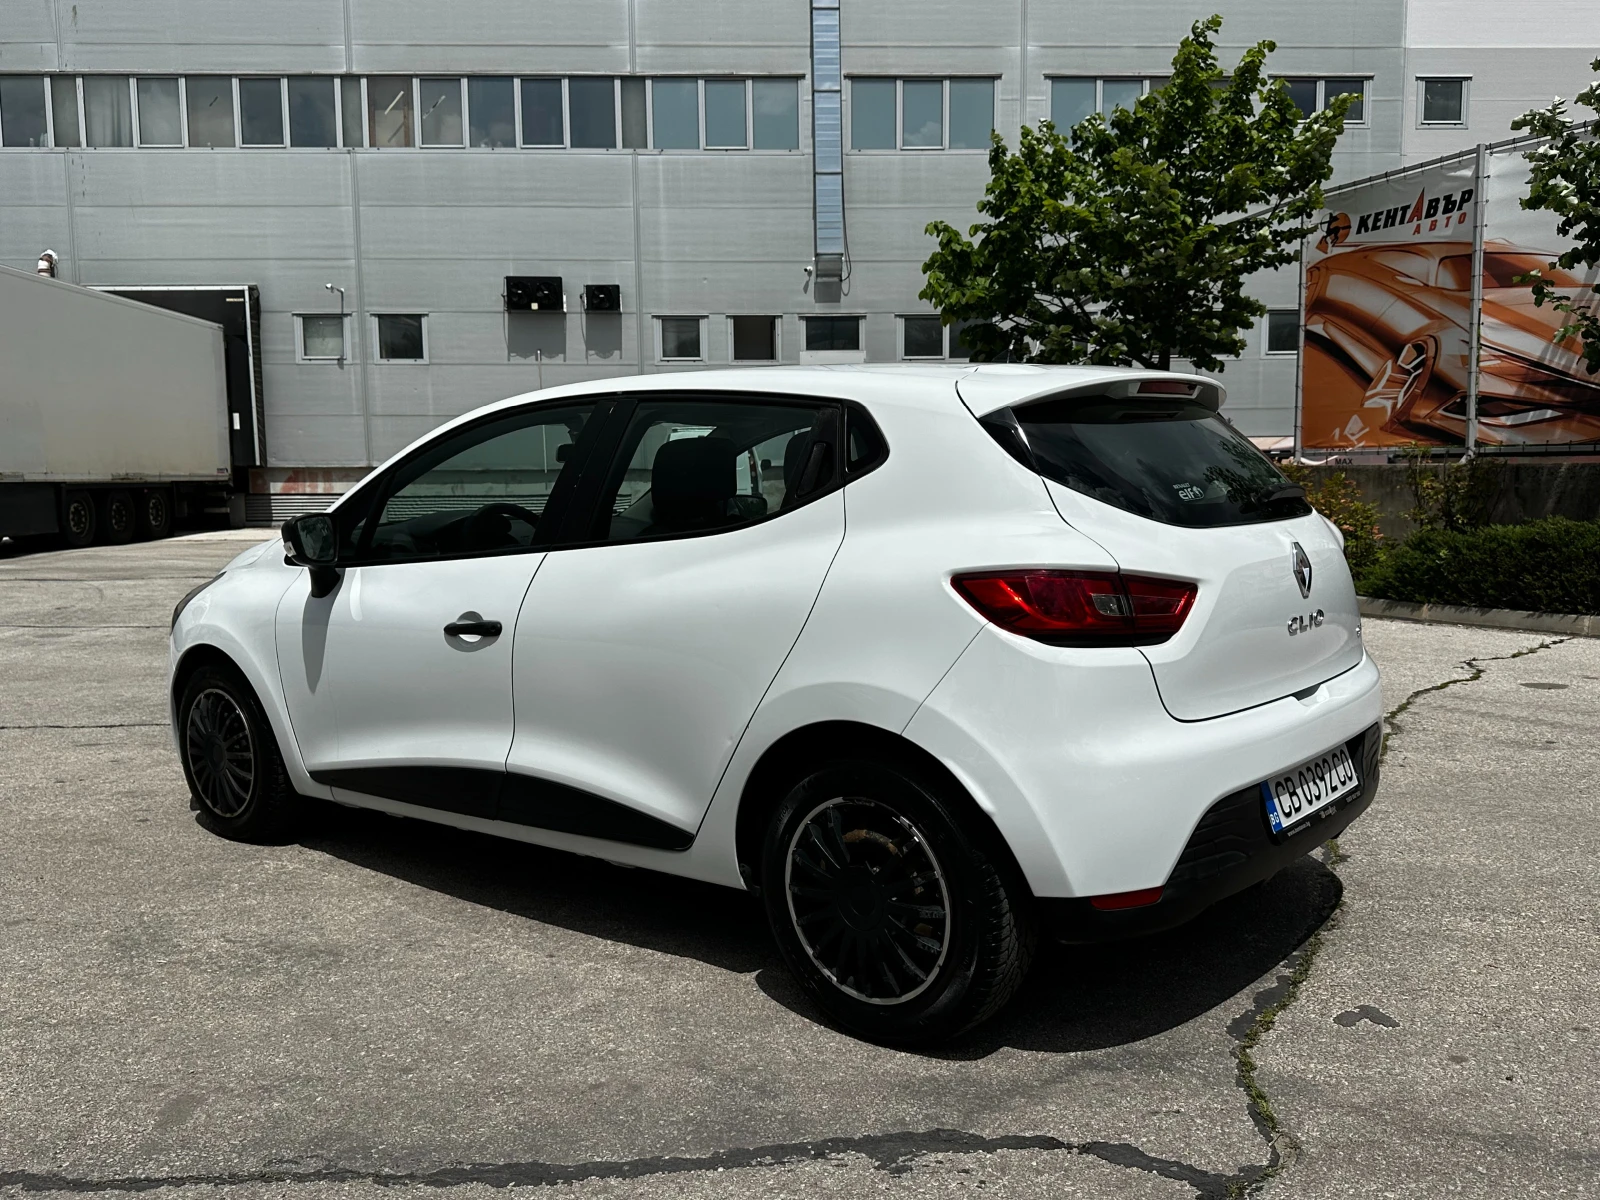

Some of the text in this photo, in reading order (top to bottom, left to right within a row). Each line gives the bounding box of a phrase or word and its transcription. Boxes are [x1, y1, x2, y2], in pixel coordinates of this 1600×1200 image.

[1356, 186, 1474, 235] КЕНТАВЪР
[1413, 212, 1467, 235] АВТО
[1178, 487, 1195, 500] elf
[1287, 608, 1325, 636] CLIO
